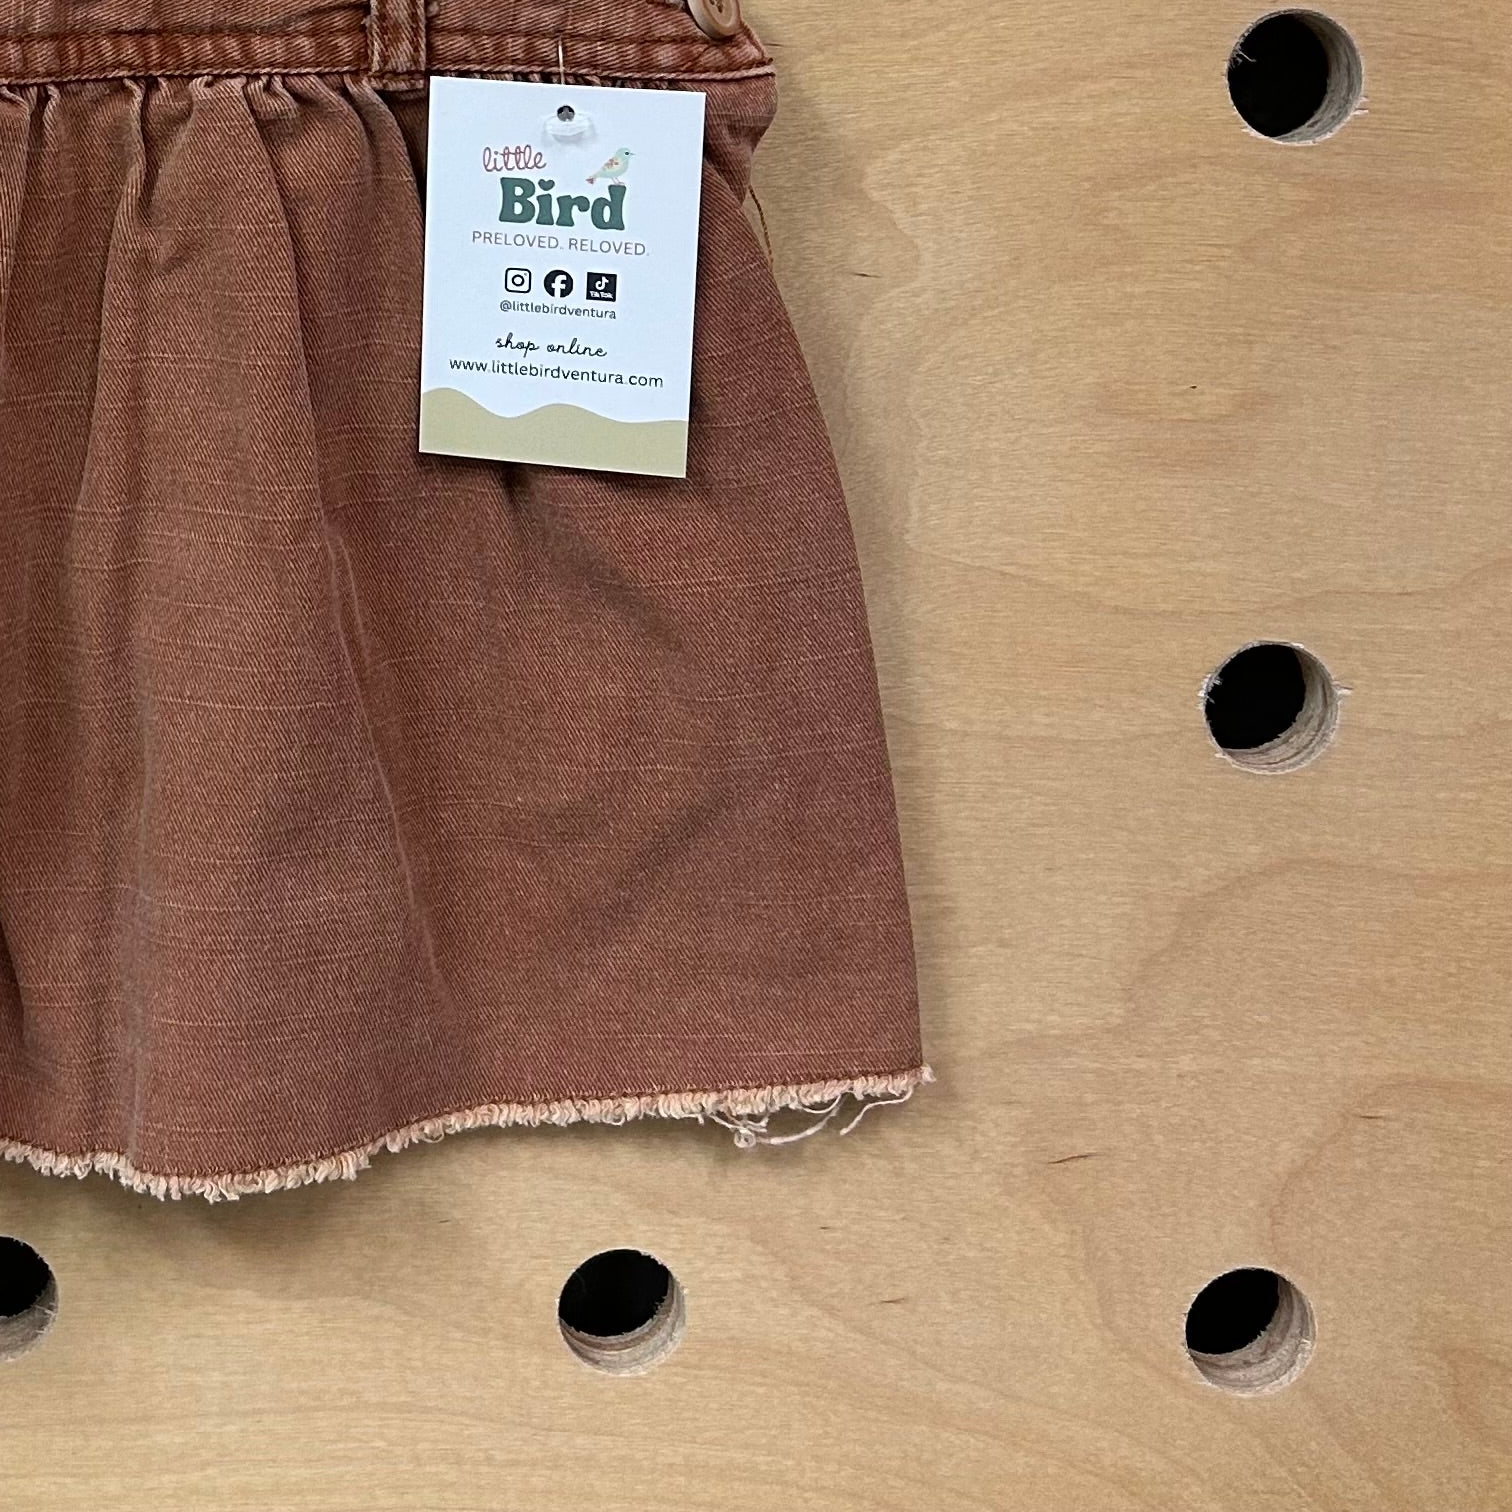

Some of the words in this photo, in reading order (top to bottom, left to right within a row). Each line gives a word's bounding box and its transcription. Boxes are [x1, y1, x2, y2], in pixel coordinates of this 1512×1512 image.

[483, 144, 547, 173] little
[499, 176, 627, 231] Bird
[472, 230, 564, 250] PRELOVED.
[568, 238, 650, 257] RELOVED.
[499, 300, 617, 320] @littlebirdventura
[495, 332, 540, 358] shop
[546, 337, 608, 357] online
[449, 358, 664, 388] www.littlebirdventura.com
